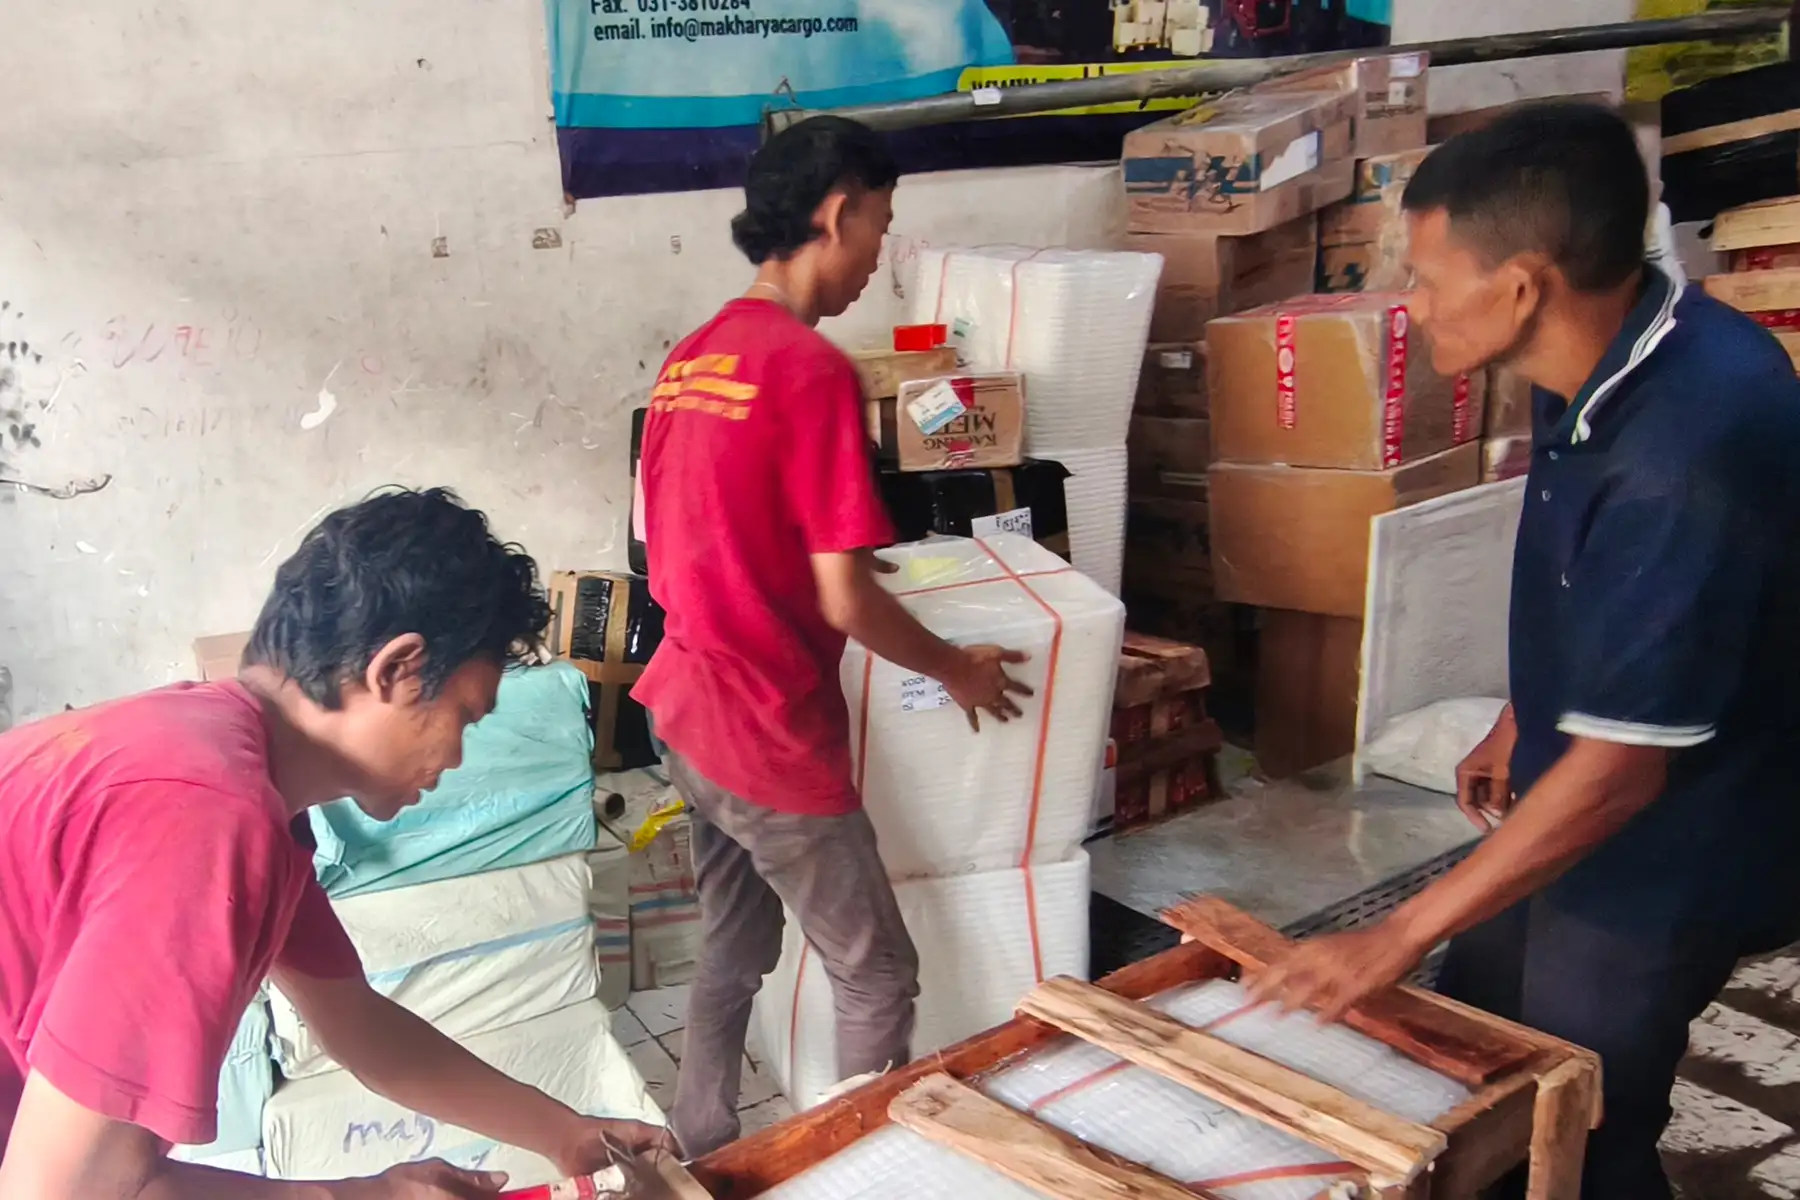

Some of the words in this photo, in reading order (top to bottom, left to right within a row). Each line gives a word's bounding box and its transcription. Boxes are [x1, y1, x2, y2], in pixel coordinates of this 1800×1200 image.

[591, 0, 628, 15] Fax.
[594, 17, 646, 41] email.
[651, 15, 858, 42] info@makharyacargo.com
